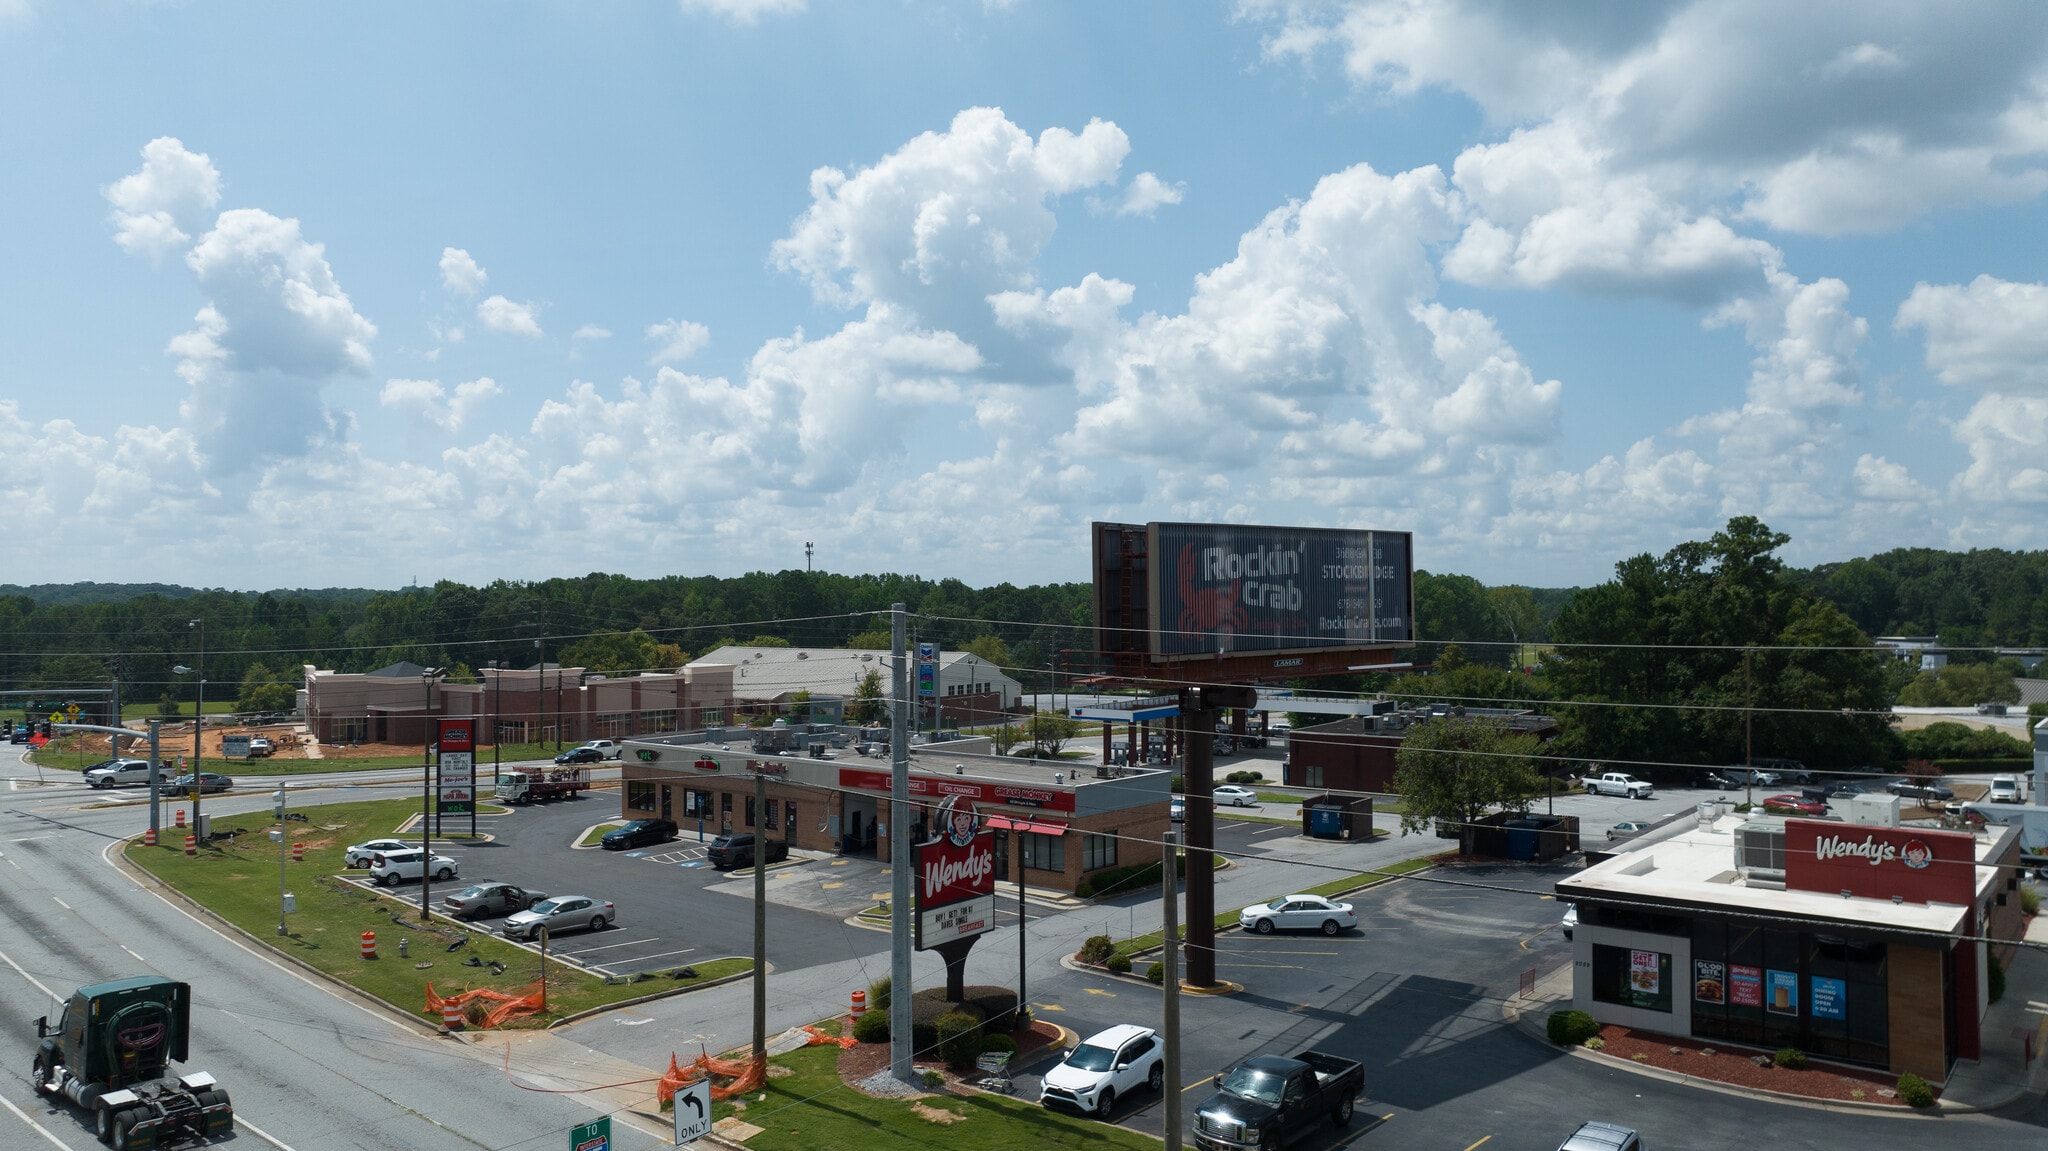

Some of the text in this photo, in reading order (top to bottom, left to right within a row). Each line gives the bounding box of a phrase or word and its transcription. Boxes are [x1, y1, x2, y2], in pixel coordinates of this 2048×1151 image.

[1203, 539, 1305, 581] Rockin'
[1322, 564, 1395, 579] STOCKBDGE
[1319, 615, 1402, 630] RockinCras.com
[1275, 658, 1302, 667] LAMAR
[954, 787, 975, 795] CHANGE
[995, 786, 1053, 801] GREASE MONKEY
[1816, 835, 1896, 866] Wendy's
[926, 845, 992, 898] Wendy's
[1697, 961, 1722, 971] GOOD
[1814, 988, 1837, 996] DINING
[1814, 993, 1834, 1001] ROOM
[586, 1124, 598, 1136] TO
[681, 1120, 707, 1138] ONLY
[579, 1138, 605, 1150] INTERSTATE
